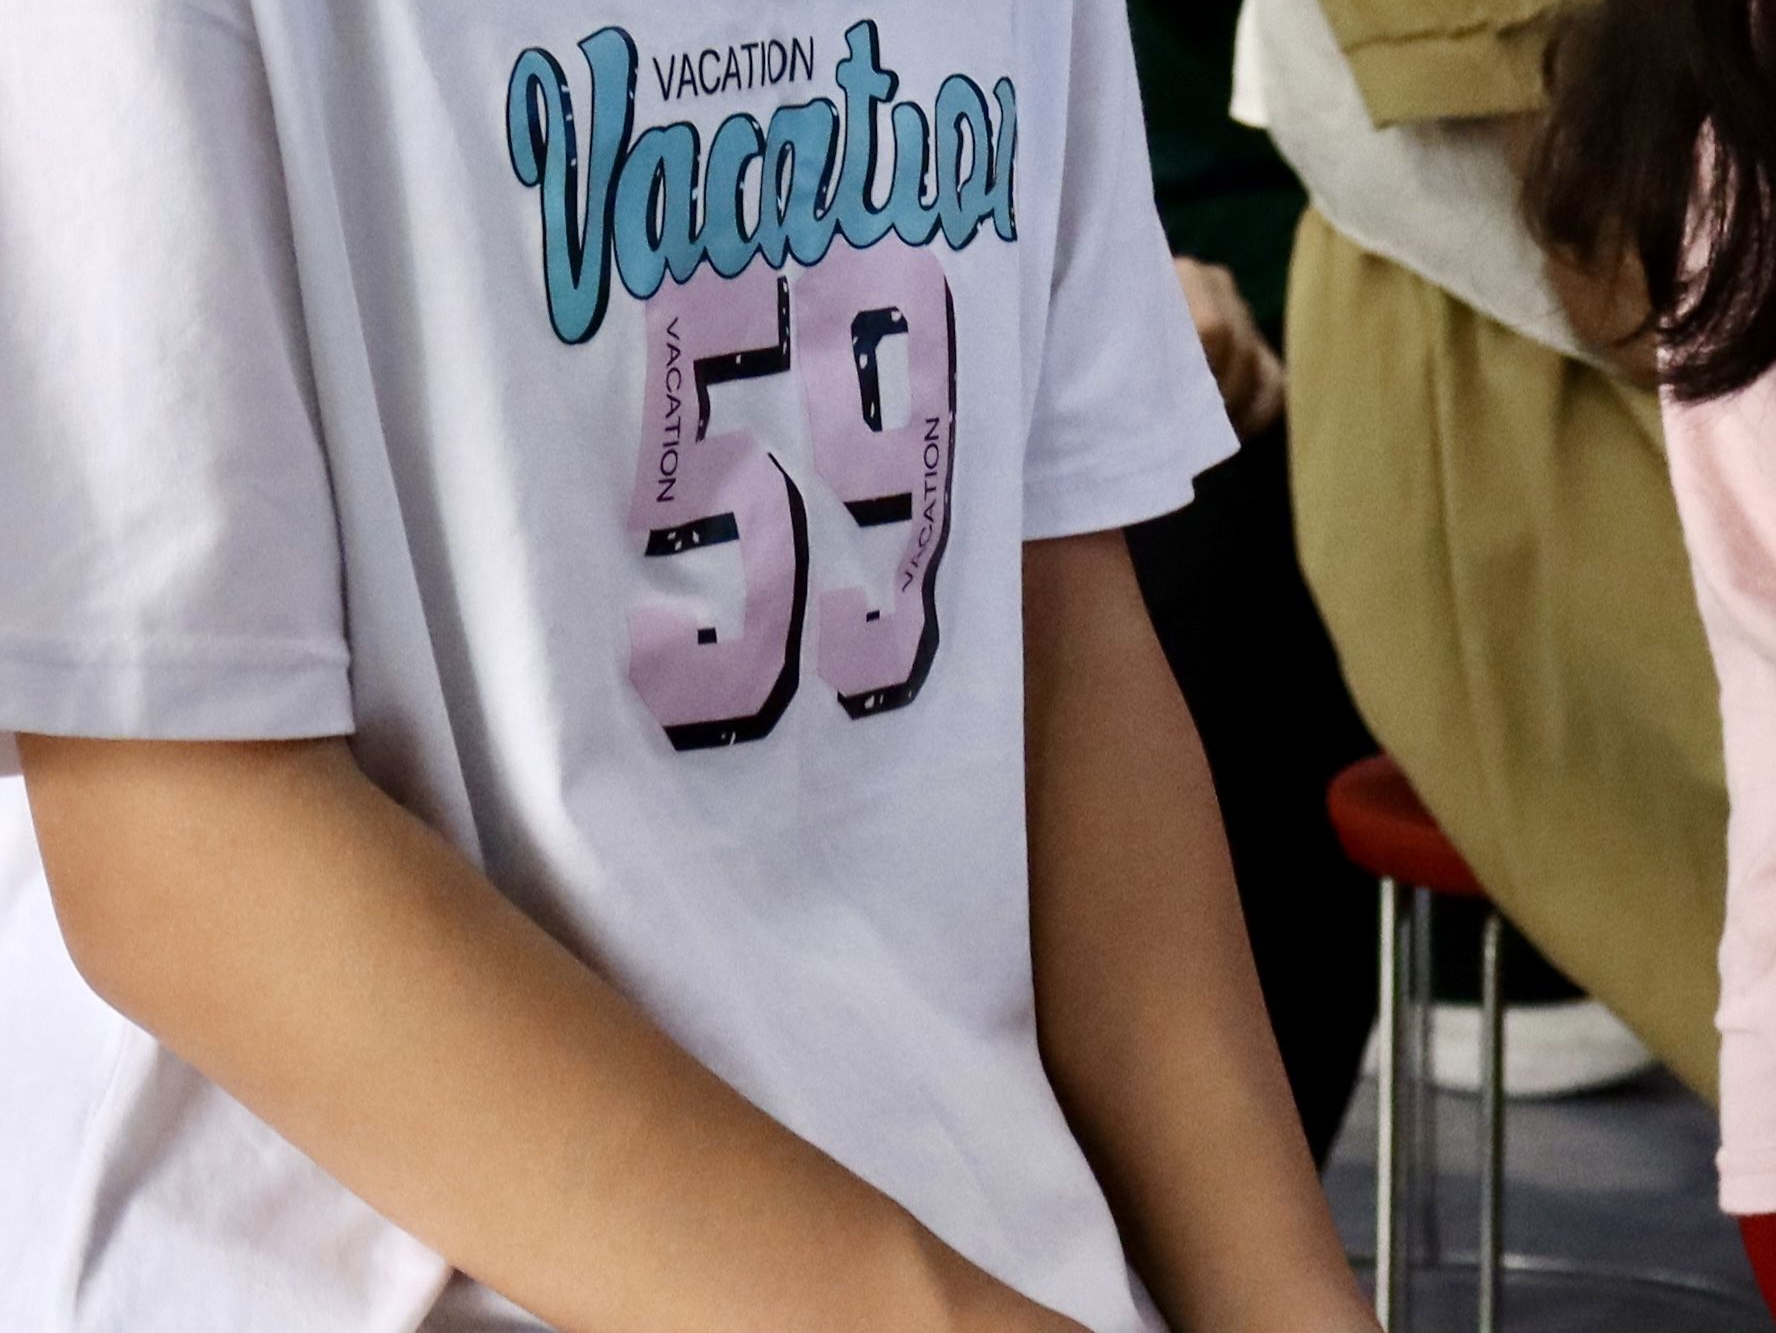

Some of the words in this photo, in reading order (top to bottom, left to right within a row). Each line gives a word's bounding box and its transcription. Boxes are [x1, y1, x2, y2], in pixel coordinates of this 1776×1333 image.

[653, 36, 815, 101] VACATION
[628, 238, 959, 752] 59
[655, 316, 682, 505] VACATION
[902, 415, 942, 593] VACATION
